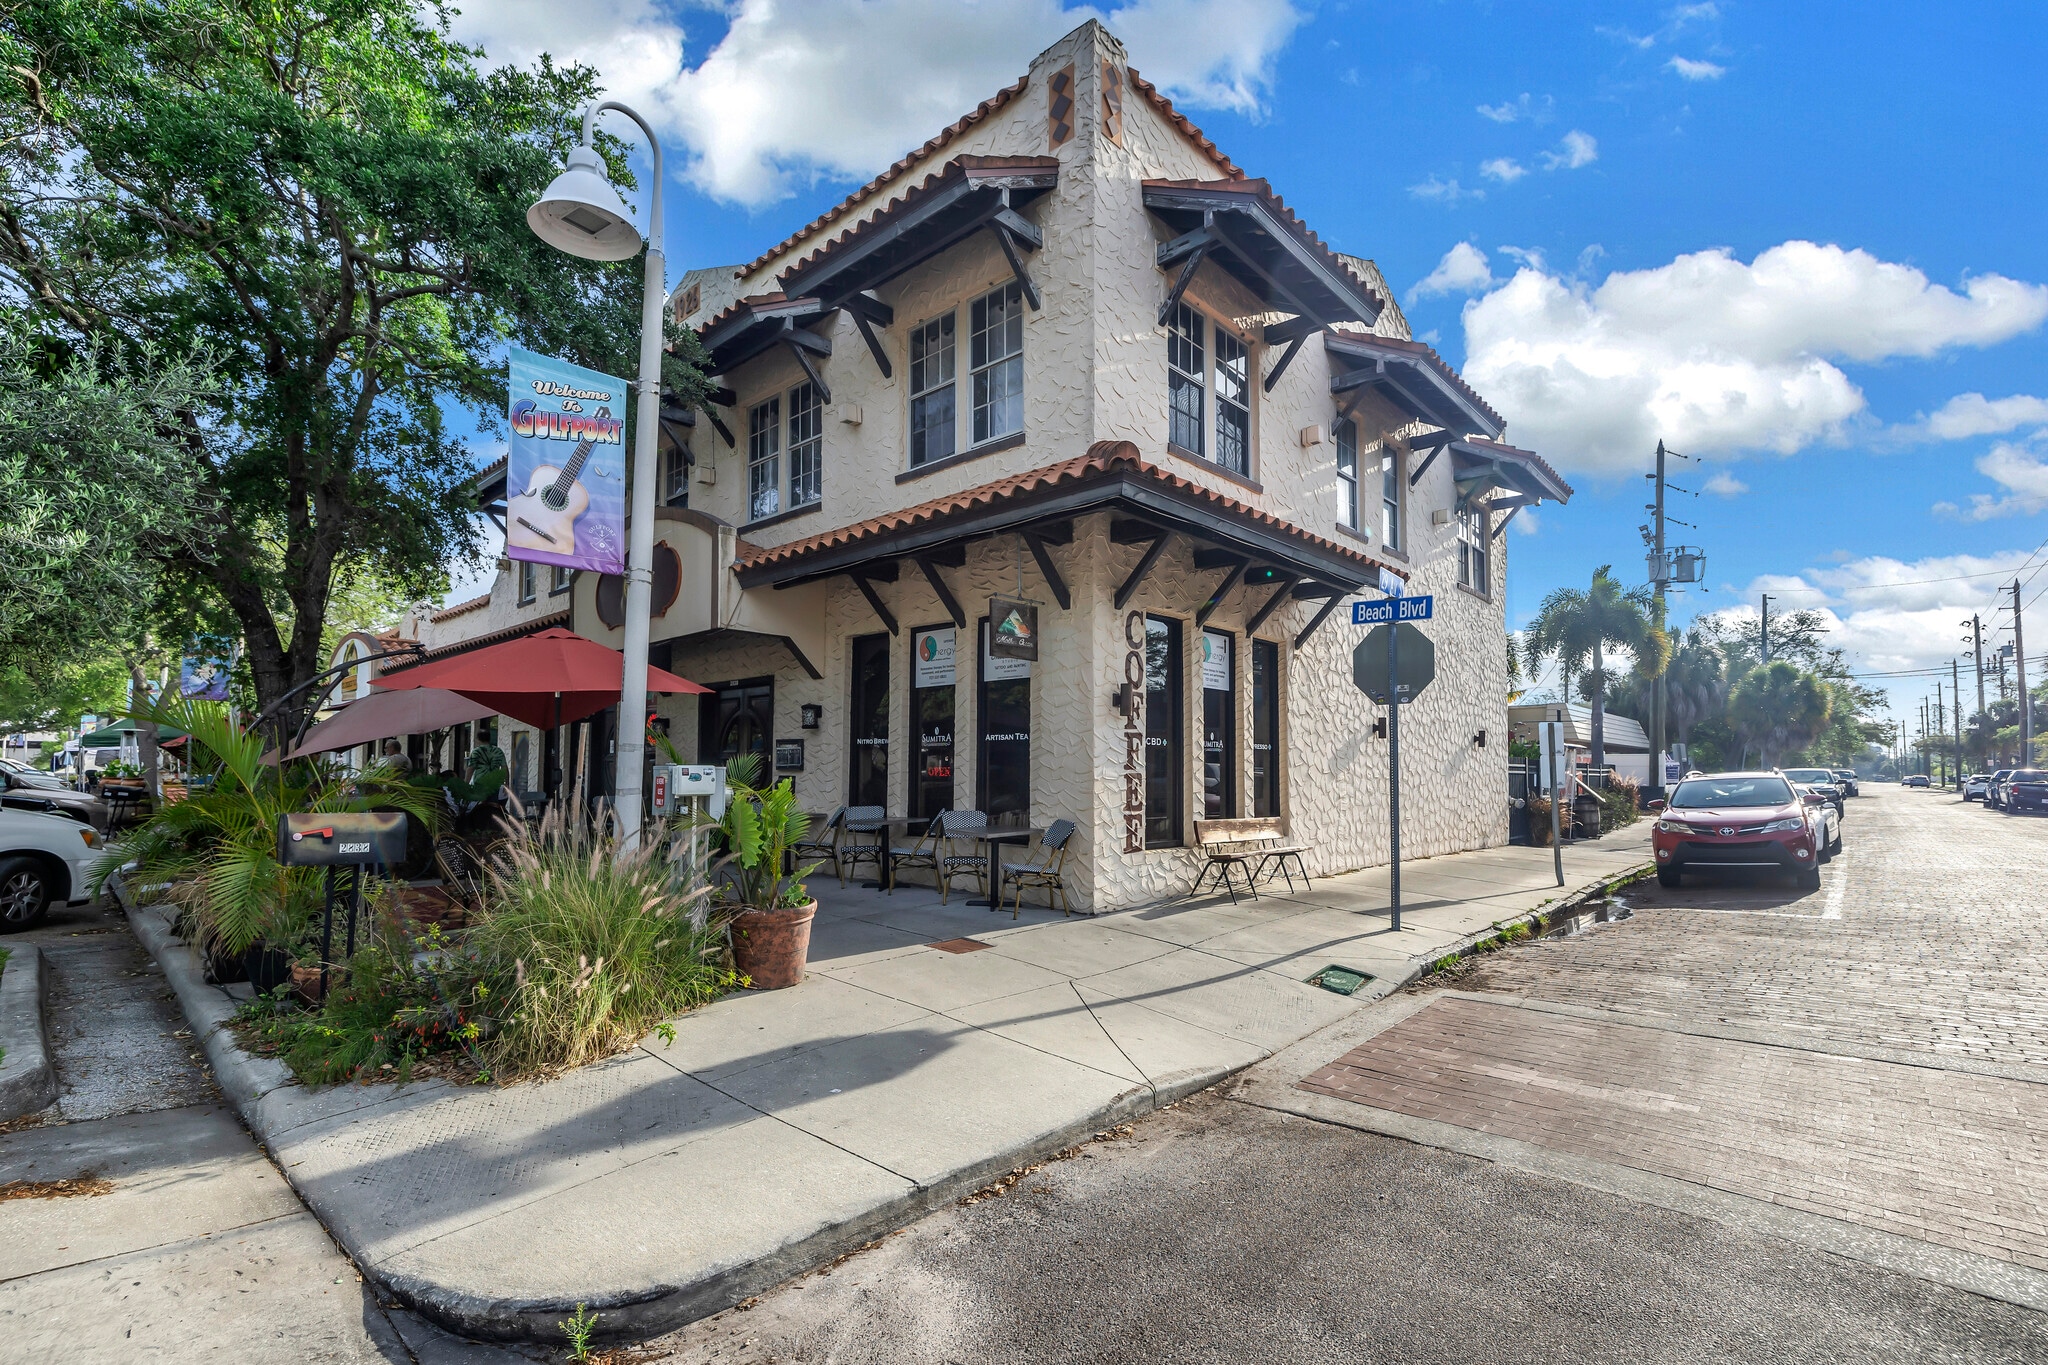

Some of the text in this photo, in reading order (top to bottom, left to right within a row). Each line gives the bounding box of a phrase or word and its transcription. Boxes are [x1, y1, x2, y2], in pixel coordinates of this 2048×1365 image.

[532, 380, 611, 401] Welcome
[562, 400, 583, 413] To
[511, 398, 623, 445] GULFPORT
[588, 524, 617, 537] GULFPORT
[1358, 599, 1426, 622] Beach Blvd
[922, 734, 951, 742] SUMITRA
[1015, 732, 1029, 740] TEA
[1124, 610, 1144, 854] COFFEE
[1145, 737, 1162, 747] CBD
[928, 767, 950, 776] OPEN
